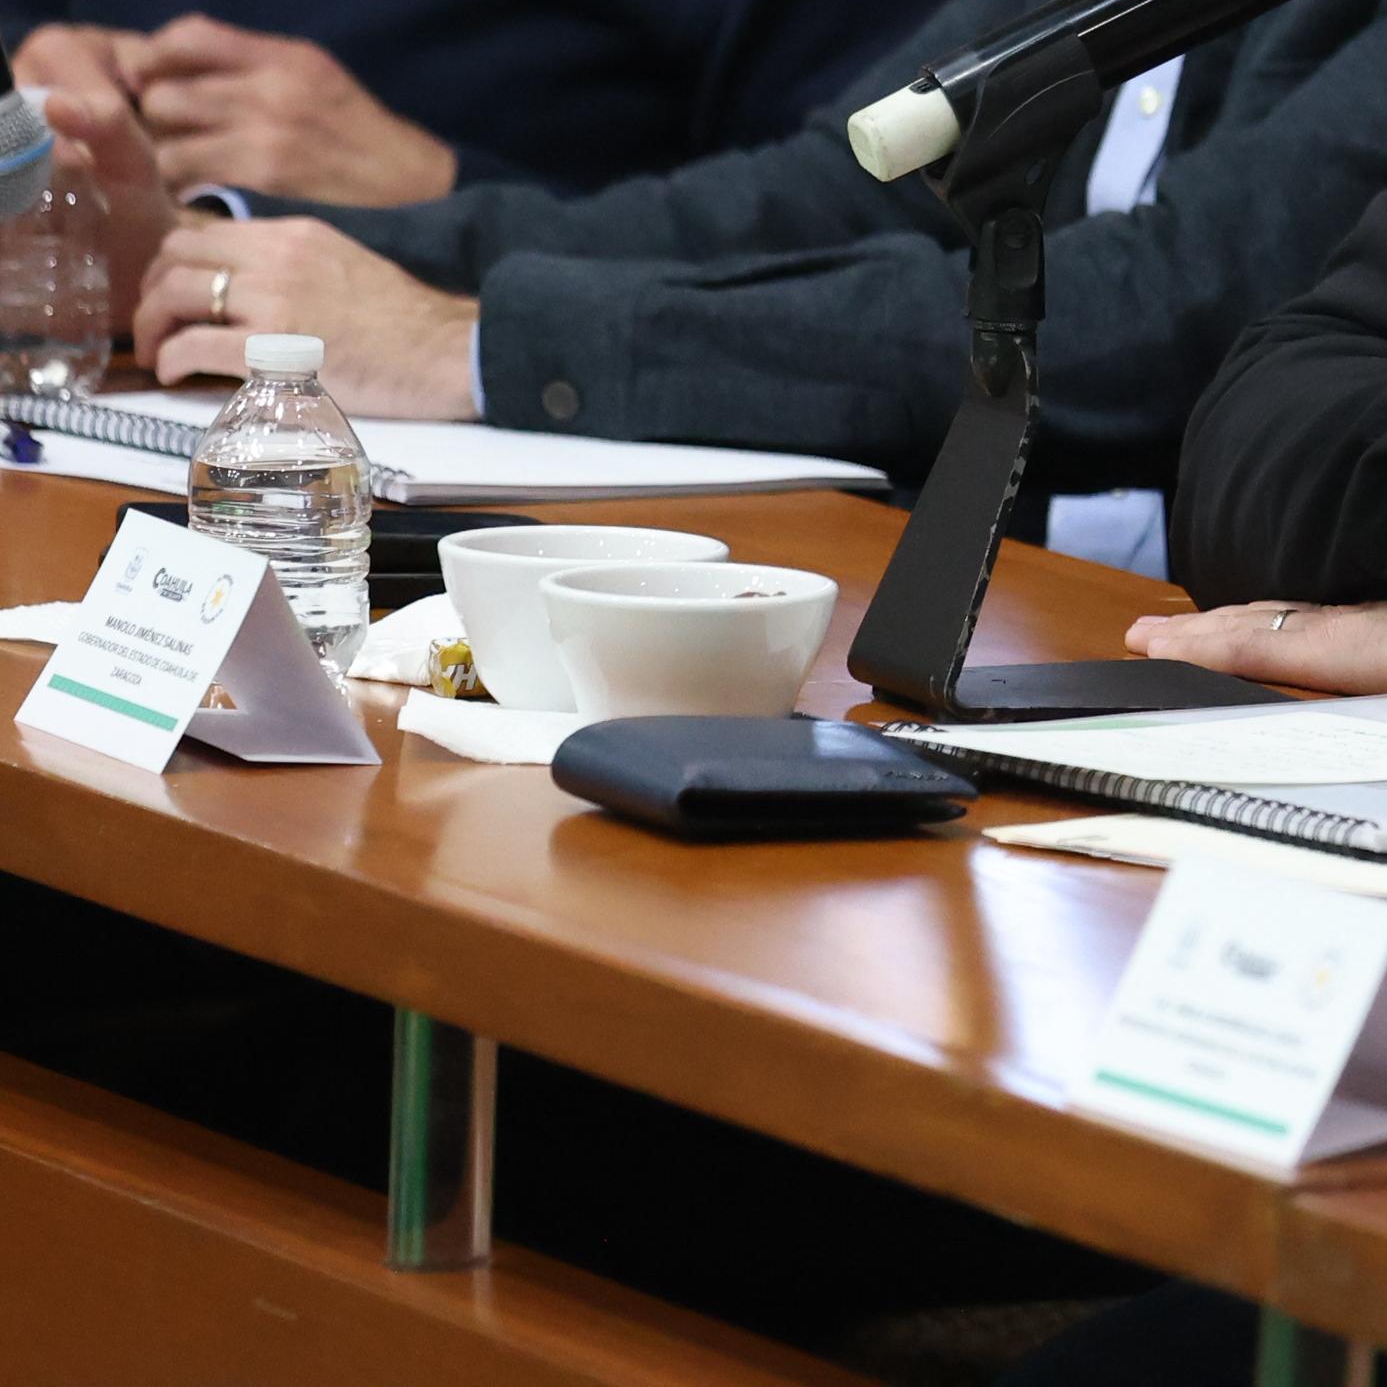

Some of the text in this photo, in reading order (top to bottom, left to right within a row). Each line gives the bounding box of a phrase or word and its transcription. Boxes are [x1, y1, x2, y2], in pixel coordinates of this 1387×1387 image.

[105, 615, 194, 656] MANOLO JIMÉNEZ SALINAS
